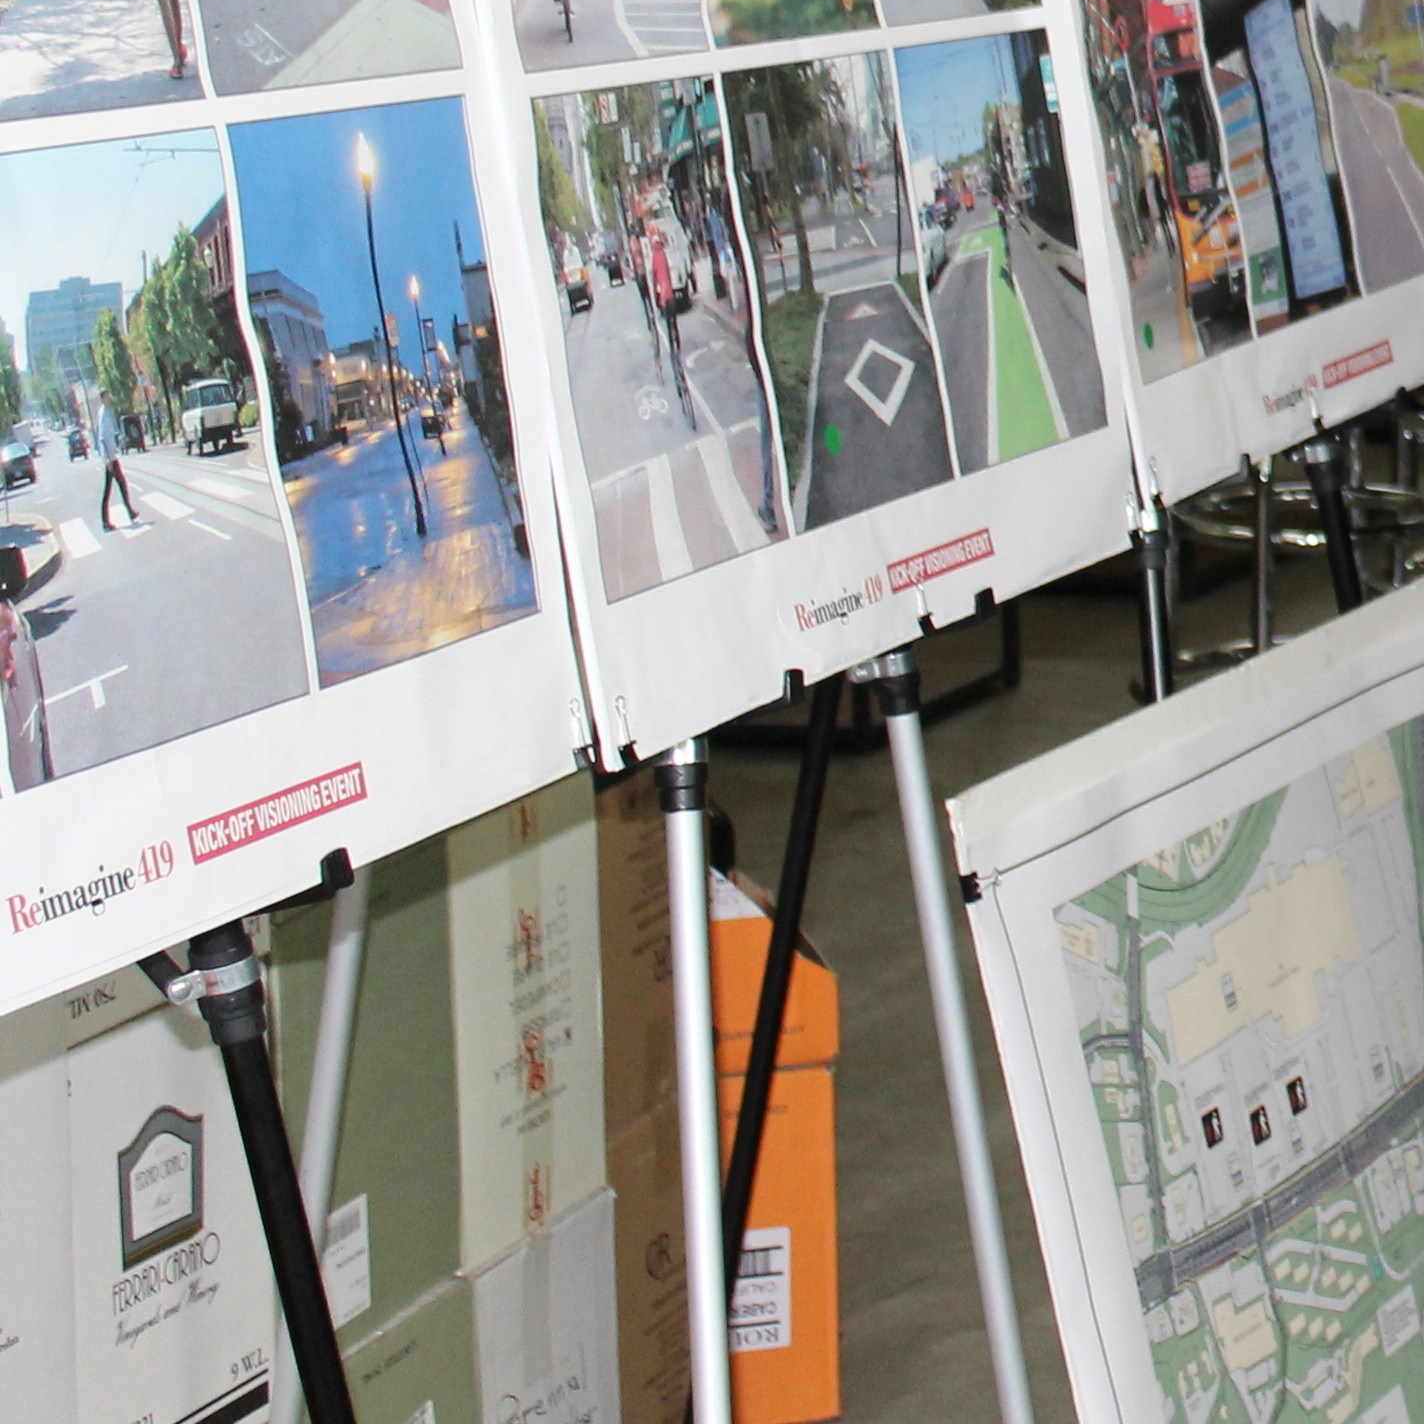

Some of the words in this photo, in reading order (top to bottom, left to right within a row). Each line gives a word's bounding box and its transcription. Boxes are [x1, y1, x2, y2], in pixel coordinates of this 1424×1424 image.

[793, 586, 864, 633] Reimagine
[863, 573, 885, 609] 419
[190, 808, 255, 858] KICK-OFF
[254, 785, 323, 832] VISIONING
[320, 768, 363, 812] EVENT
[6, 864, 136, 935] Reimagine
[137, 839, 175, 885] 419
